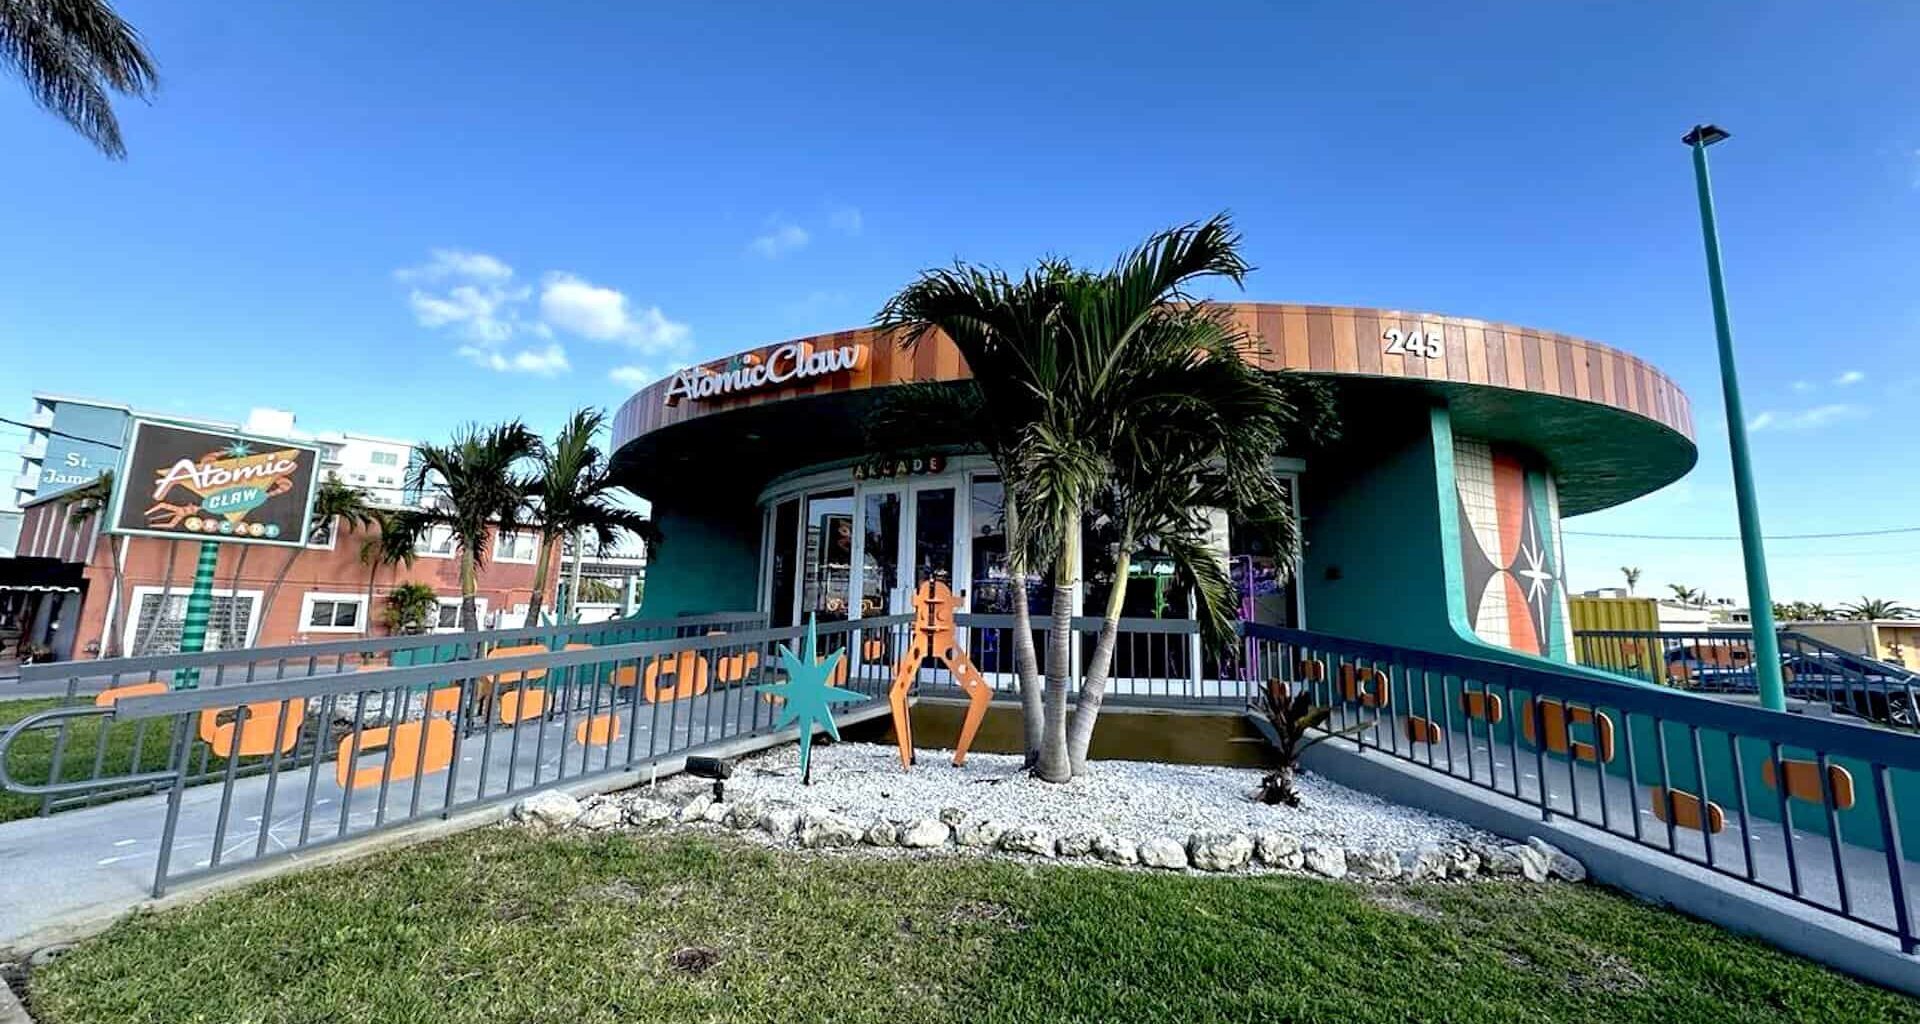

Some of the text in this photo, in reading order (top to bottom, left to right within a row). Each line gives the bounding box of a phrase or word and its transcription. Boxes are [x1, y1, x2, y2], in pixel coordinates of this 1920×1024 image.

[1384, 327, 1444, 359] 245
[42, 468, 97, 486] Jame
[153, 453, 297, 500] Atomic
[209, 489, 258, 509] CLAW
